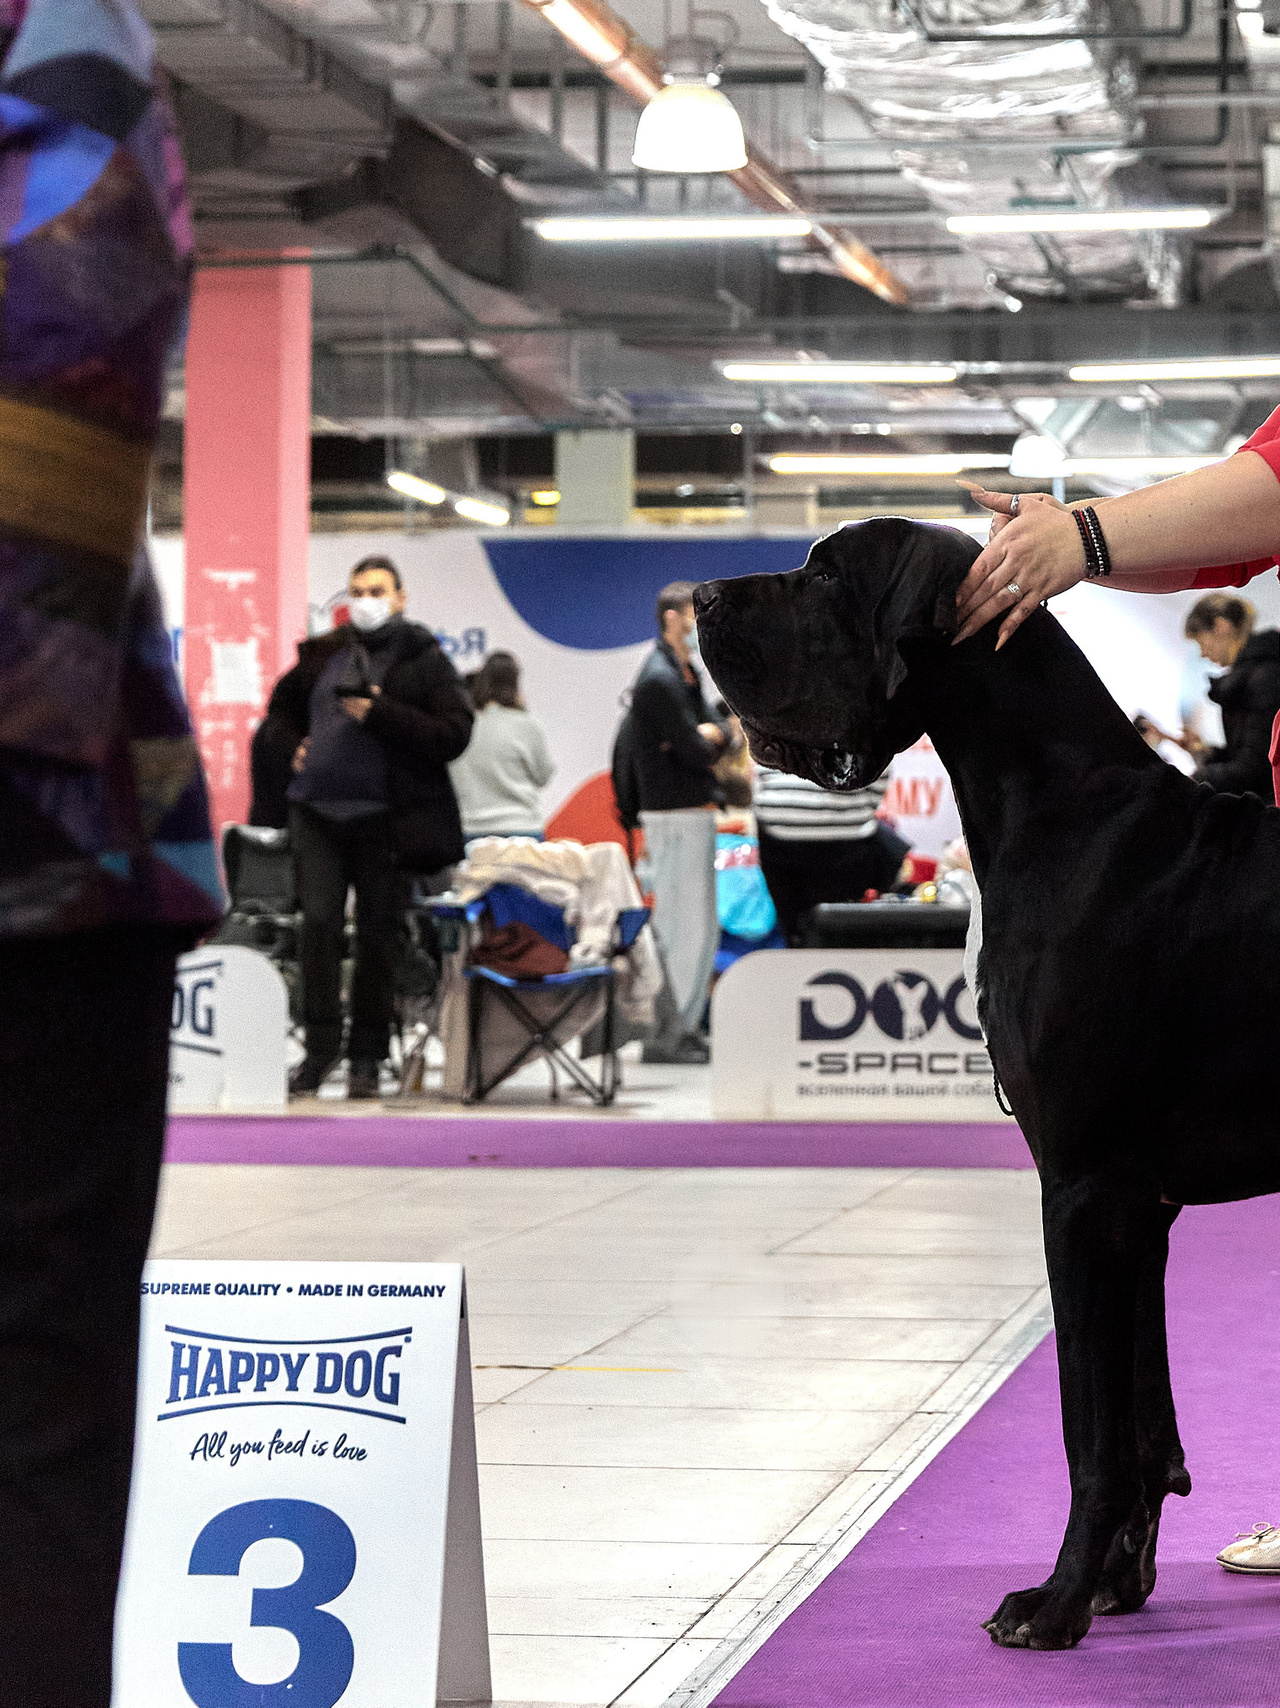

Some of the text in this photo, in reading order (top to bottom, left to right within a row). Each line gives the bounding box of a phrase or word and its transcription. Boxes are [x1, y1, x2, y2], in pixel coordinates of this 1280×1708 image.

[140, 1282, 447, 1298] SUPREME QUALITY MADE IN GERMANY
[165, 1340, 404, 1406] HAPPY DOG
[189, 1428, 368, 1467] All you feed is love
[177, 1497, 357, 1708] 3
